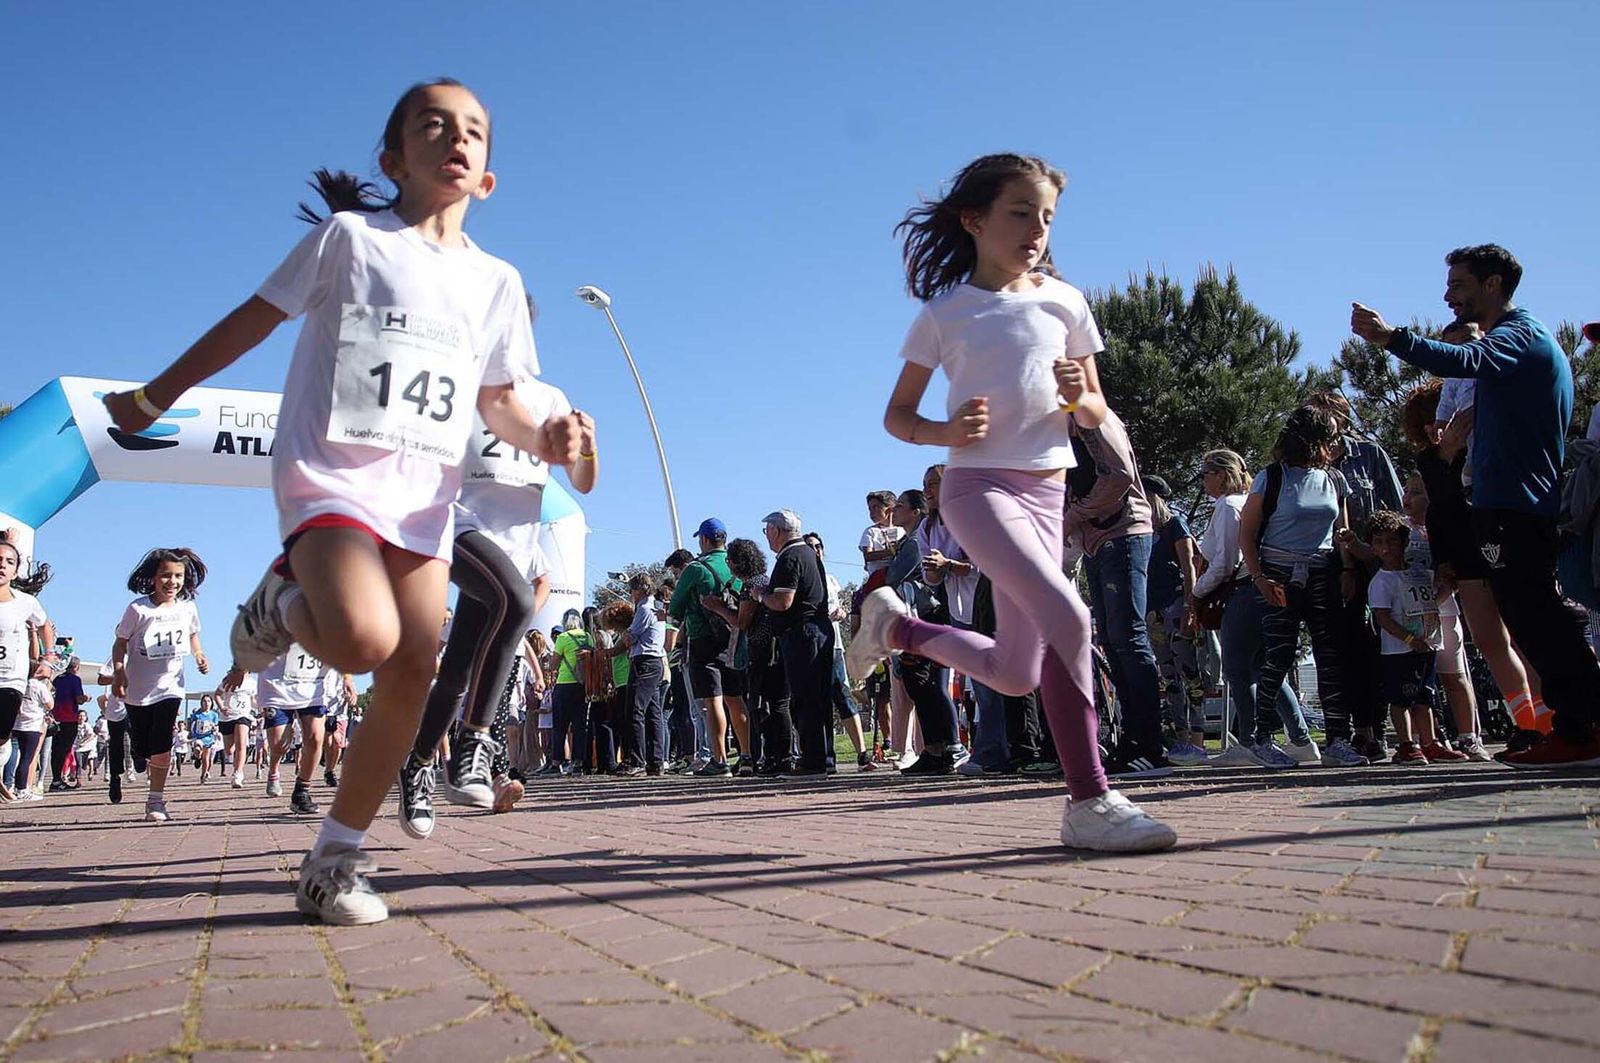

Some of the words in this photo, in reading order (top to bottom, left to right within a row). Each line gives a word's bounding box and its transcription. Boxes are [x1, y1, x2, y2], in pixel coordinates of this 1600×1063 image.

[385, 311, 407, 328] H
[369, 361, 456, 422] 143
[344, 427, 384, 440] Huelva
[212, 431, 275, 457] ATL
[471, 470, 495, 479] Huelva
[153, 629, 183, 647] 112
[236, 701, 246, 709] 75
